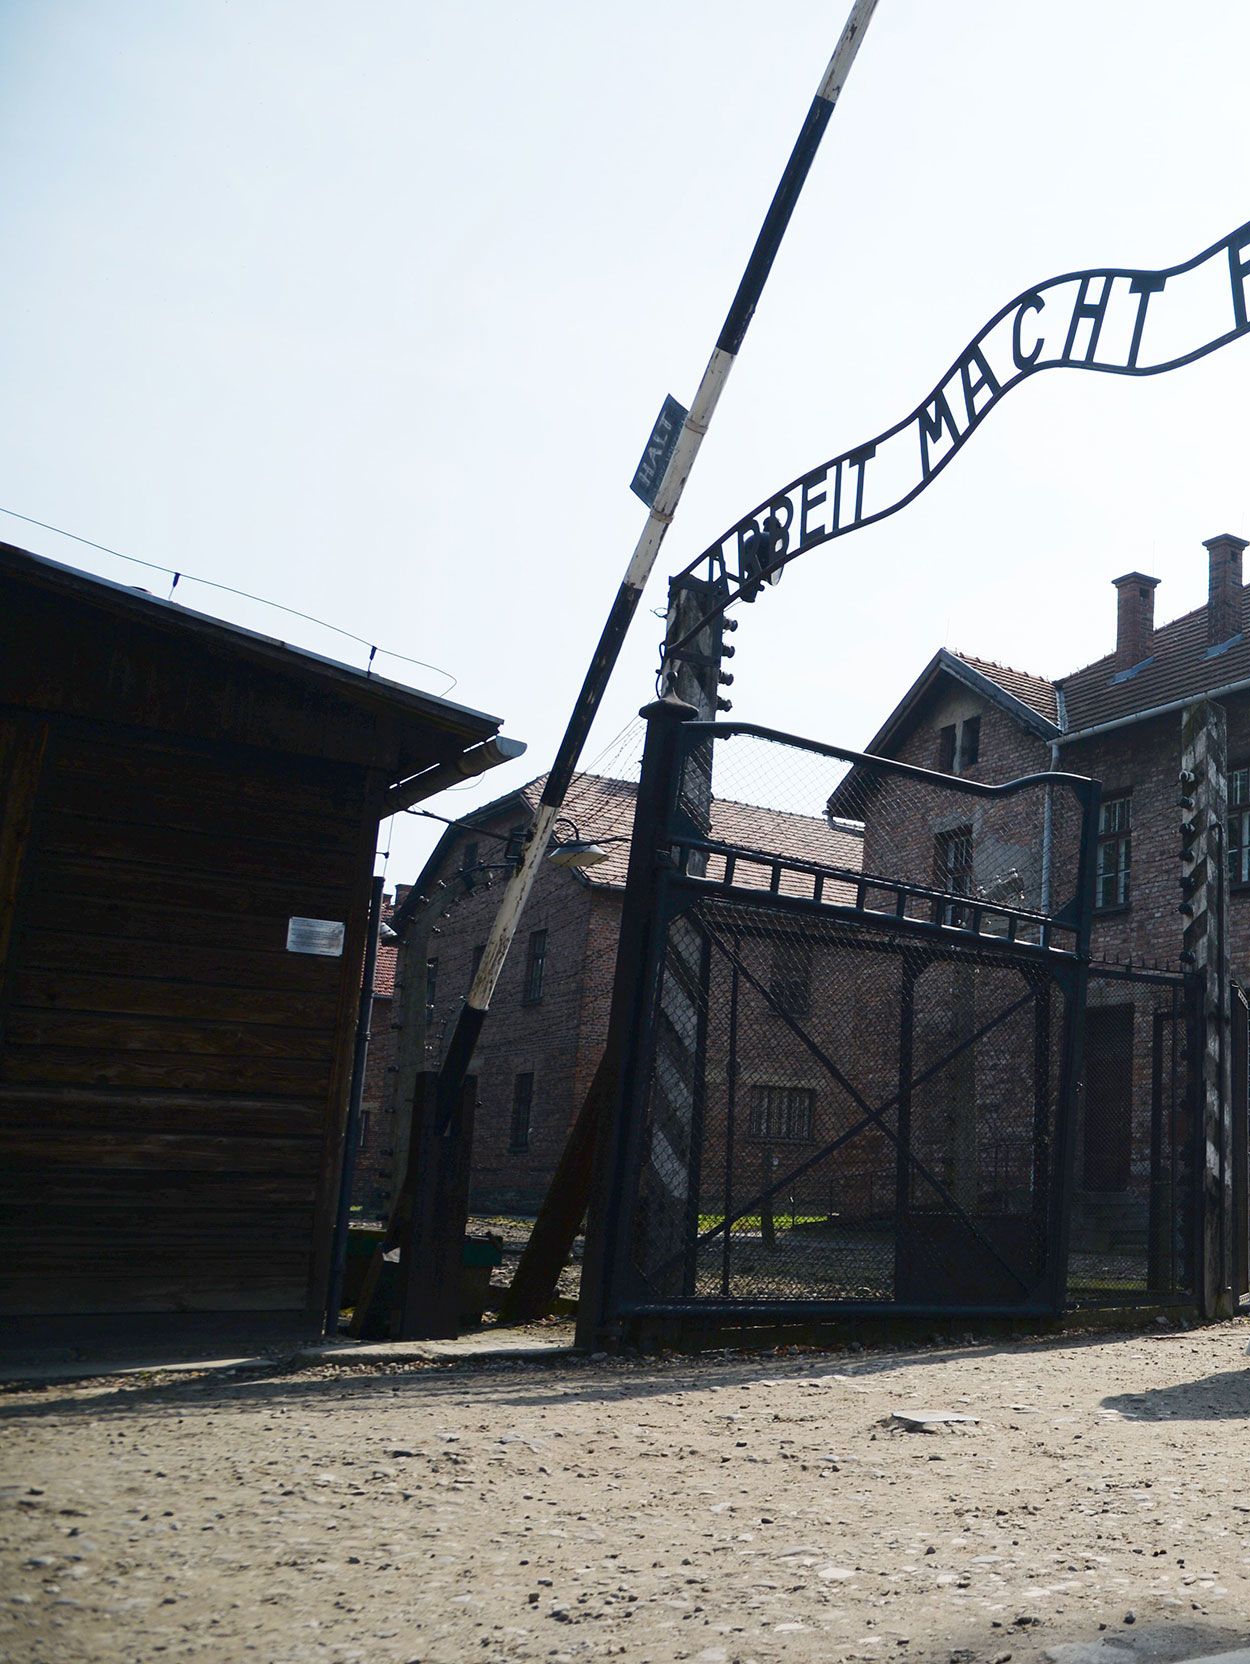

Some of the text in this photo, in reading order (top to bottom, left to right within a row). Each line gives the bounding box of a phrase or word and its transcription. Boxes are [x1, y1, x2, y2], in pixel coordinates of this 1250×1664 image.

[638, 411, 672, 486] HALT
[706, 447, 876, 604] ARBEIT
[918, 275, 1166, 479] MACHT
